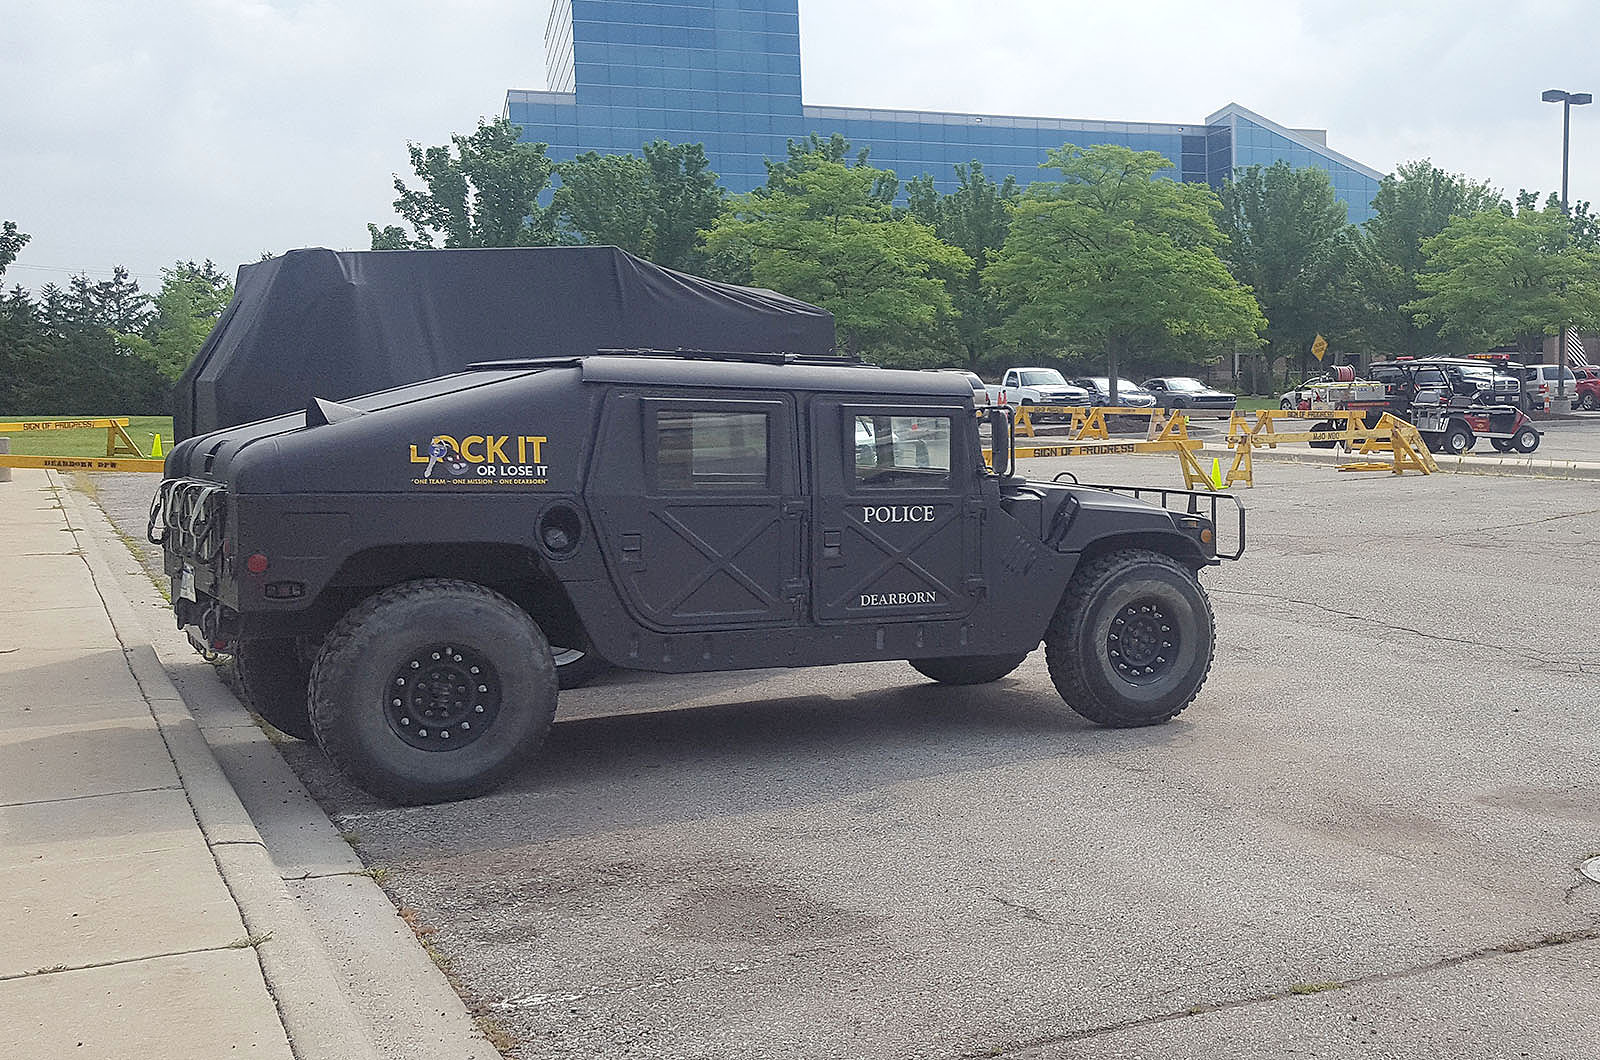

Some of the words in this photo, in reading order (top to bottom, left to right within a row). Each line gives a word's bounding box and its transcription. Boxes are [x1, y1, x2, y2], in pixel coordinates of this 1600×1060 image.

[23, 422, 40, 431] SIGN
[42, 422, 52, 430] OF
[410, 435, 510, 463] LOCK
[518, 435, 547, 463] IT
[1033, 447, 1058, 457] SIGN
[1060, 446, 1074, 456] OF
[1079, 443, 1135, 455] PROGRESS
[44, 460, 93, 468] DEARBORN
[97, 461, 117, 469] DPW
[476, 465, 497, 476] OR
[500, 465, 533, 476] LOSE
[537, 465, 548, 476] IT
[862, 505, 935, 523] POLICE
[860, 591, 937, 606] DEARBORN
